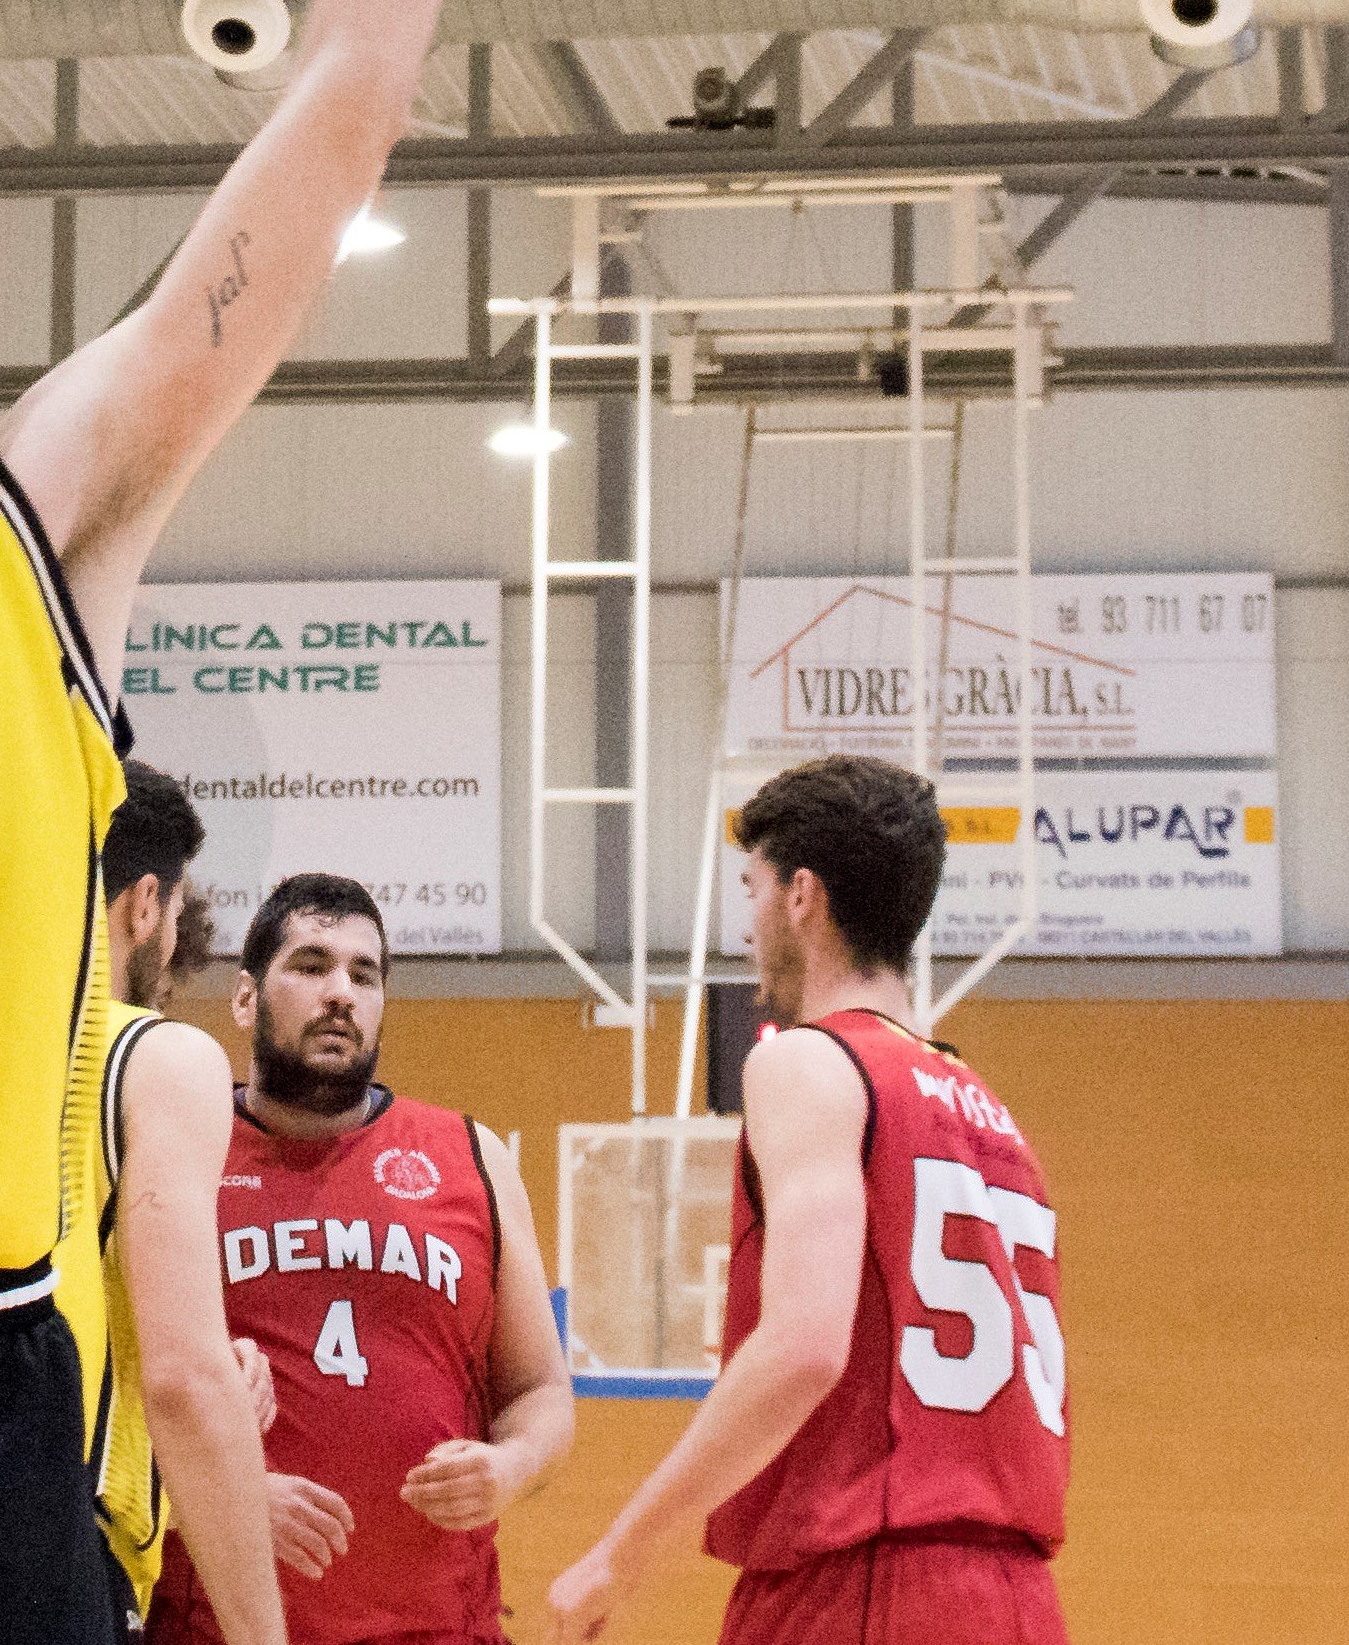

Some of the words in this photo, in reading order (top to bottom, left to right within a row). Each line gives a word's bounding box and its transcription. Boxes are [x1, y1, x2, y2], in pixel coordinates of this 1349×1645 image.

[124, 622, 284, 652] LINICA
[301, 620, 489, 649] DENTAL
[1101, 595, 1128, 634] 93
[1145, 595, 1181, 633] 711
[1202, 594, 1226, 632] 67
[193, 663, 381, 694] CENTRE
[797, 666, 933, 717] VIDRE
[1033, 804, 1237, 858] ALUPAR
[414, 883, 449, 906] 45
[454, 882, 488, 906] 90
[223, 1218, 463, 1305] DEMAR
[901, 1157, 1066, 1437] 55
[313, 1300, 369, 1386] 4
